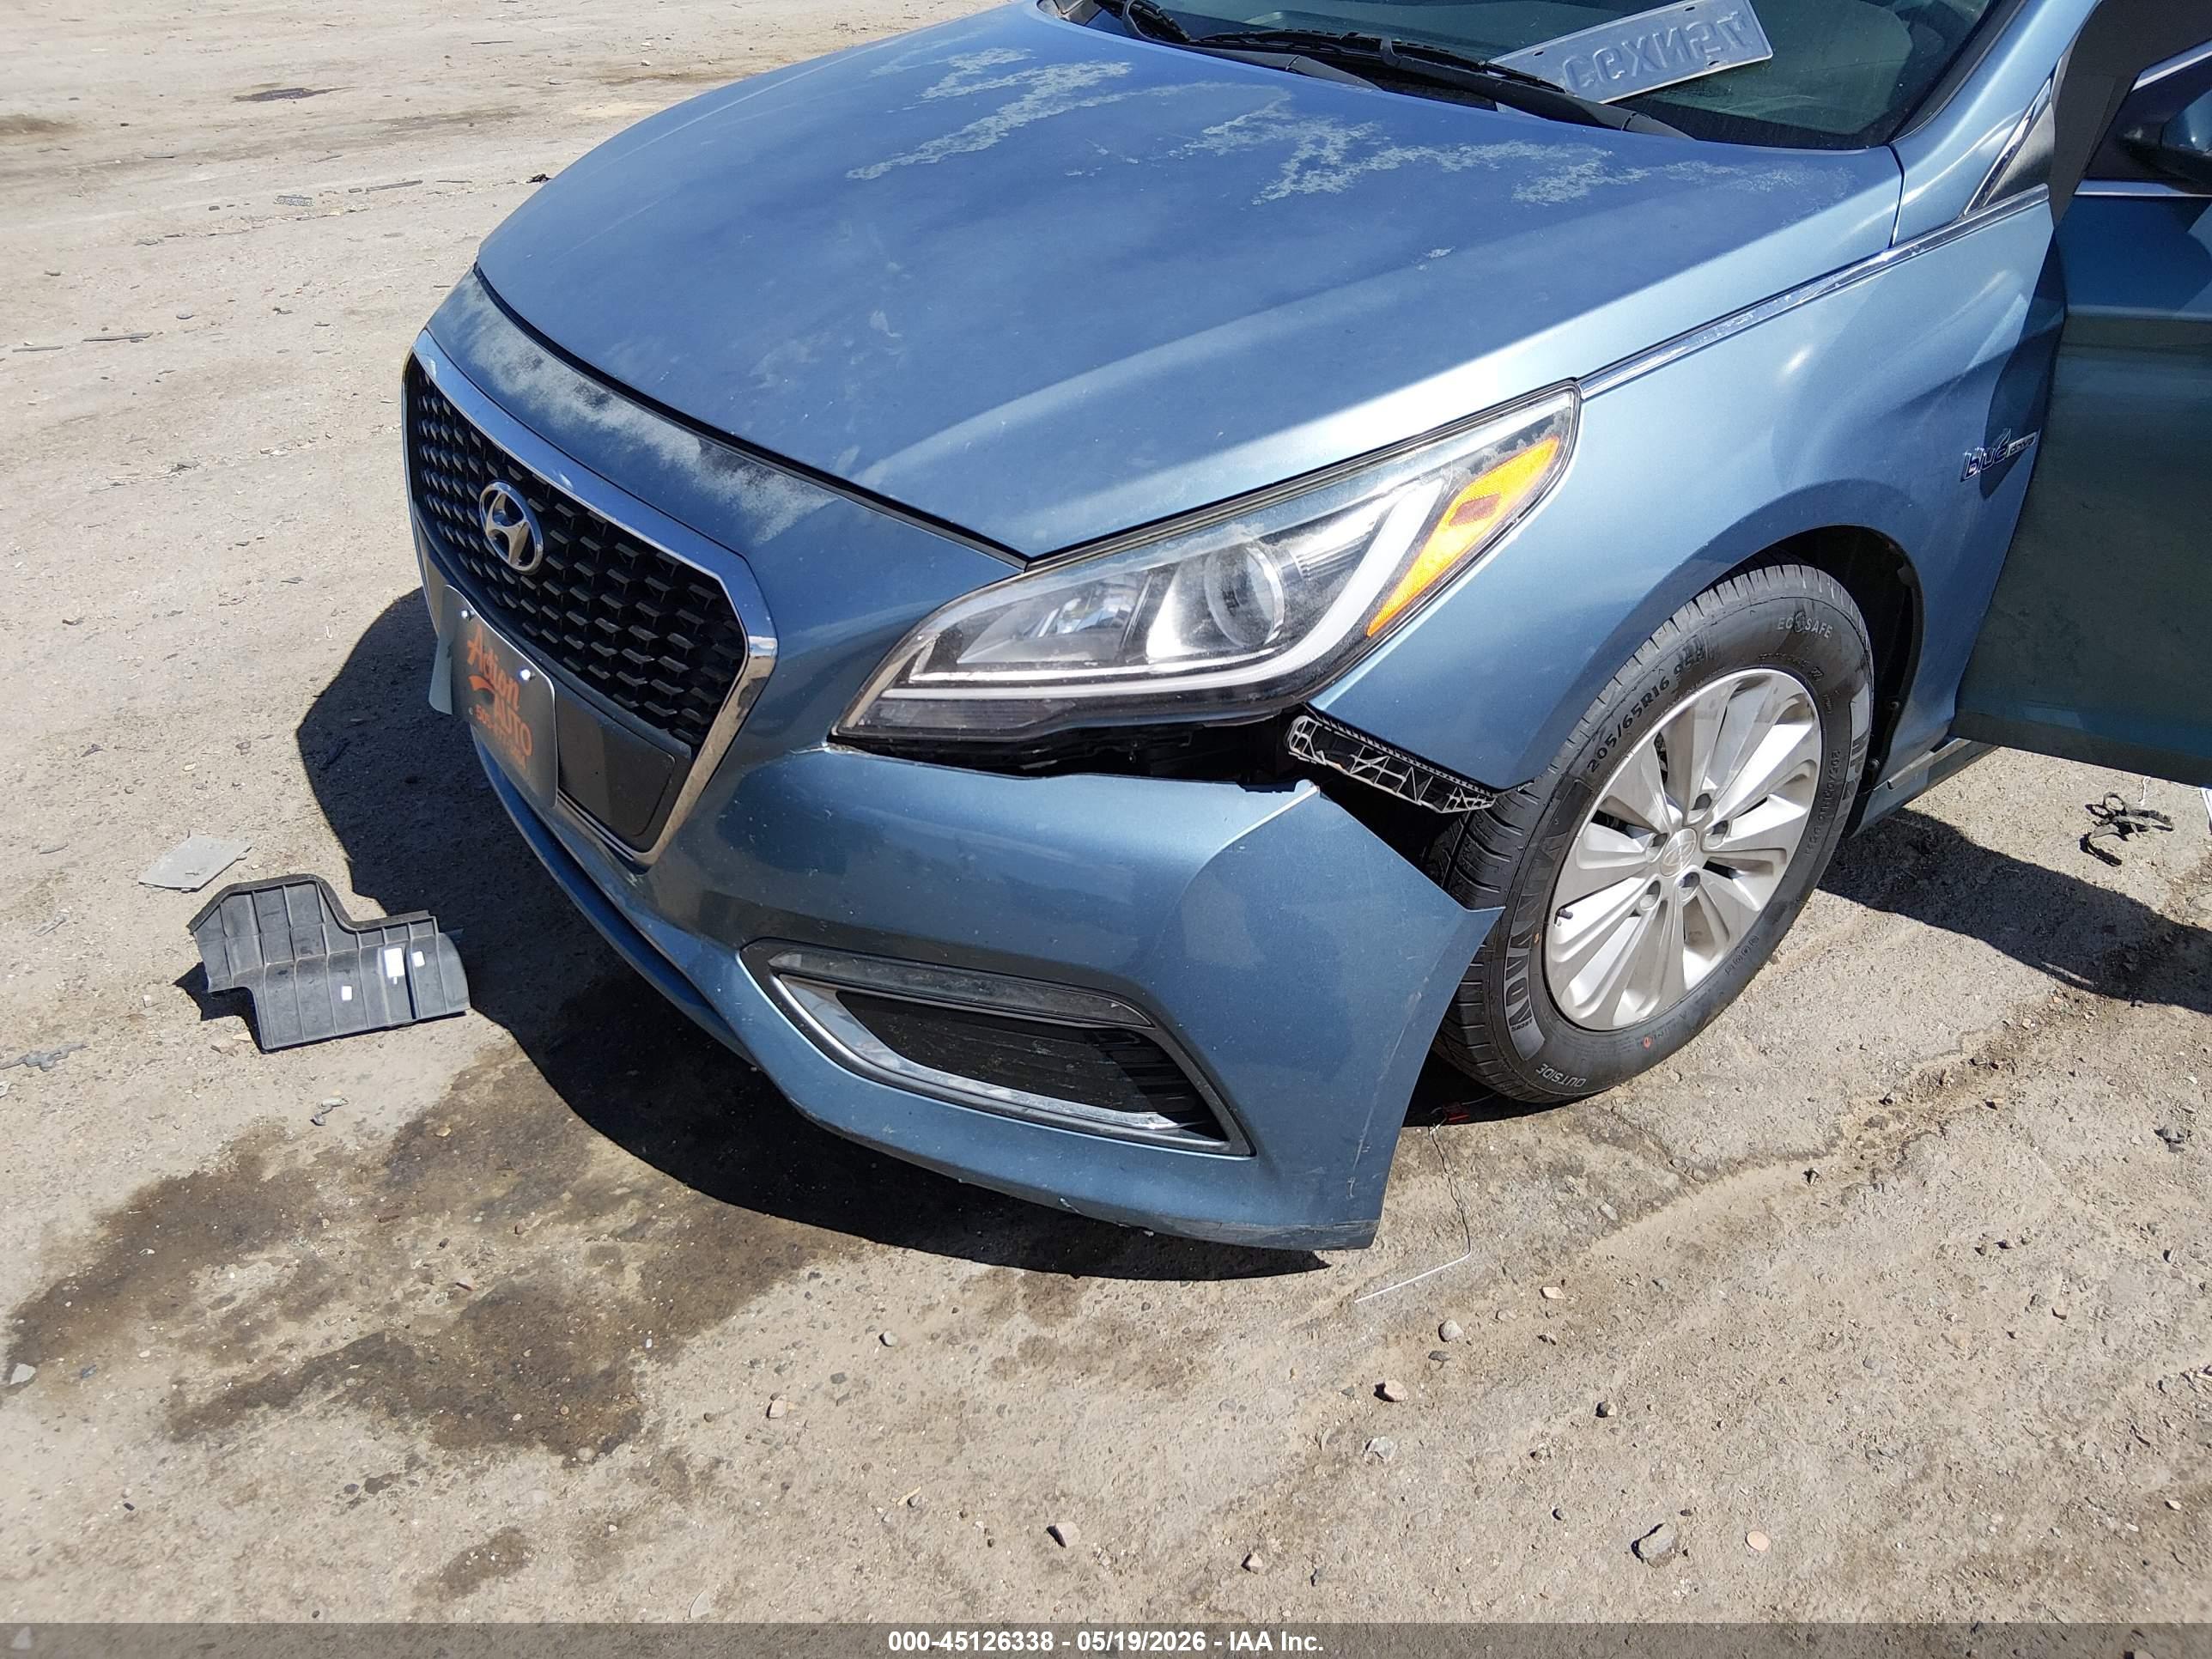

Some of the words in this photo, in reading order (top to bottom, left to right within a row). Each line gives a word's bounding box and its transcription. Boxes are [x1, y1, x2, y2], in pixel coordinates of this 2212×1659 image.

[466, 623, 520, 712] Action
[494, 689, 533, 757] AUTO
[1586, 675, 1671, 774] 205/65R16
[1534, 1062, 1588, 1088] OUTSIDE
